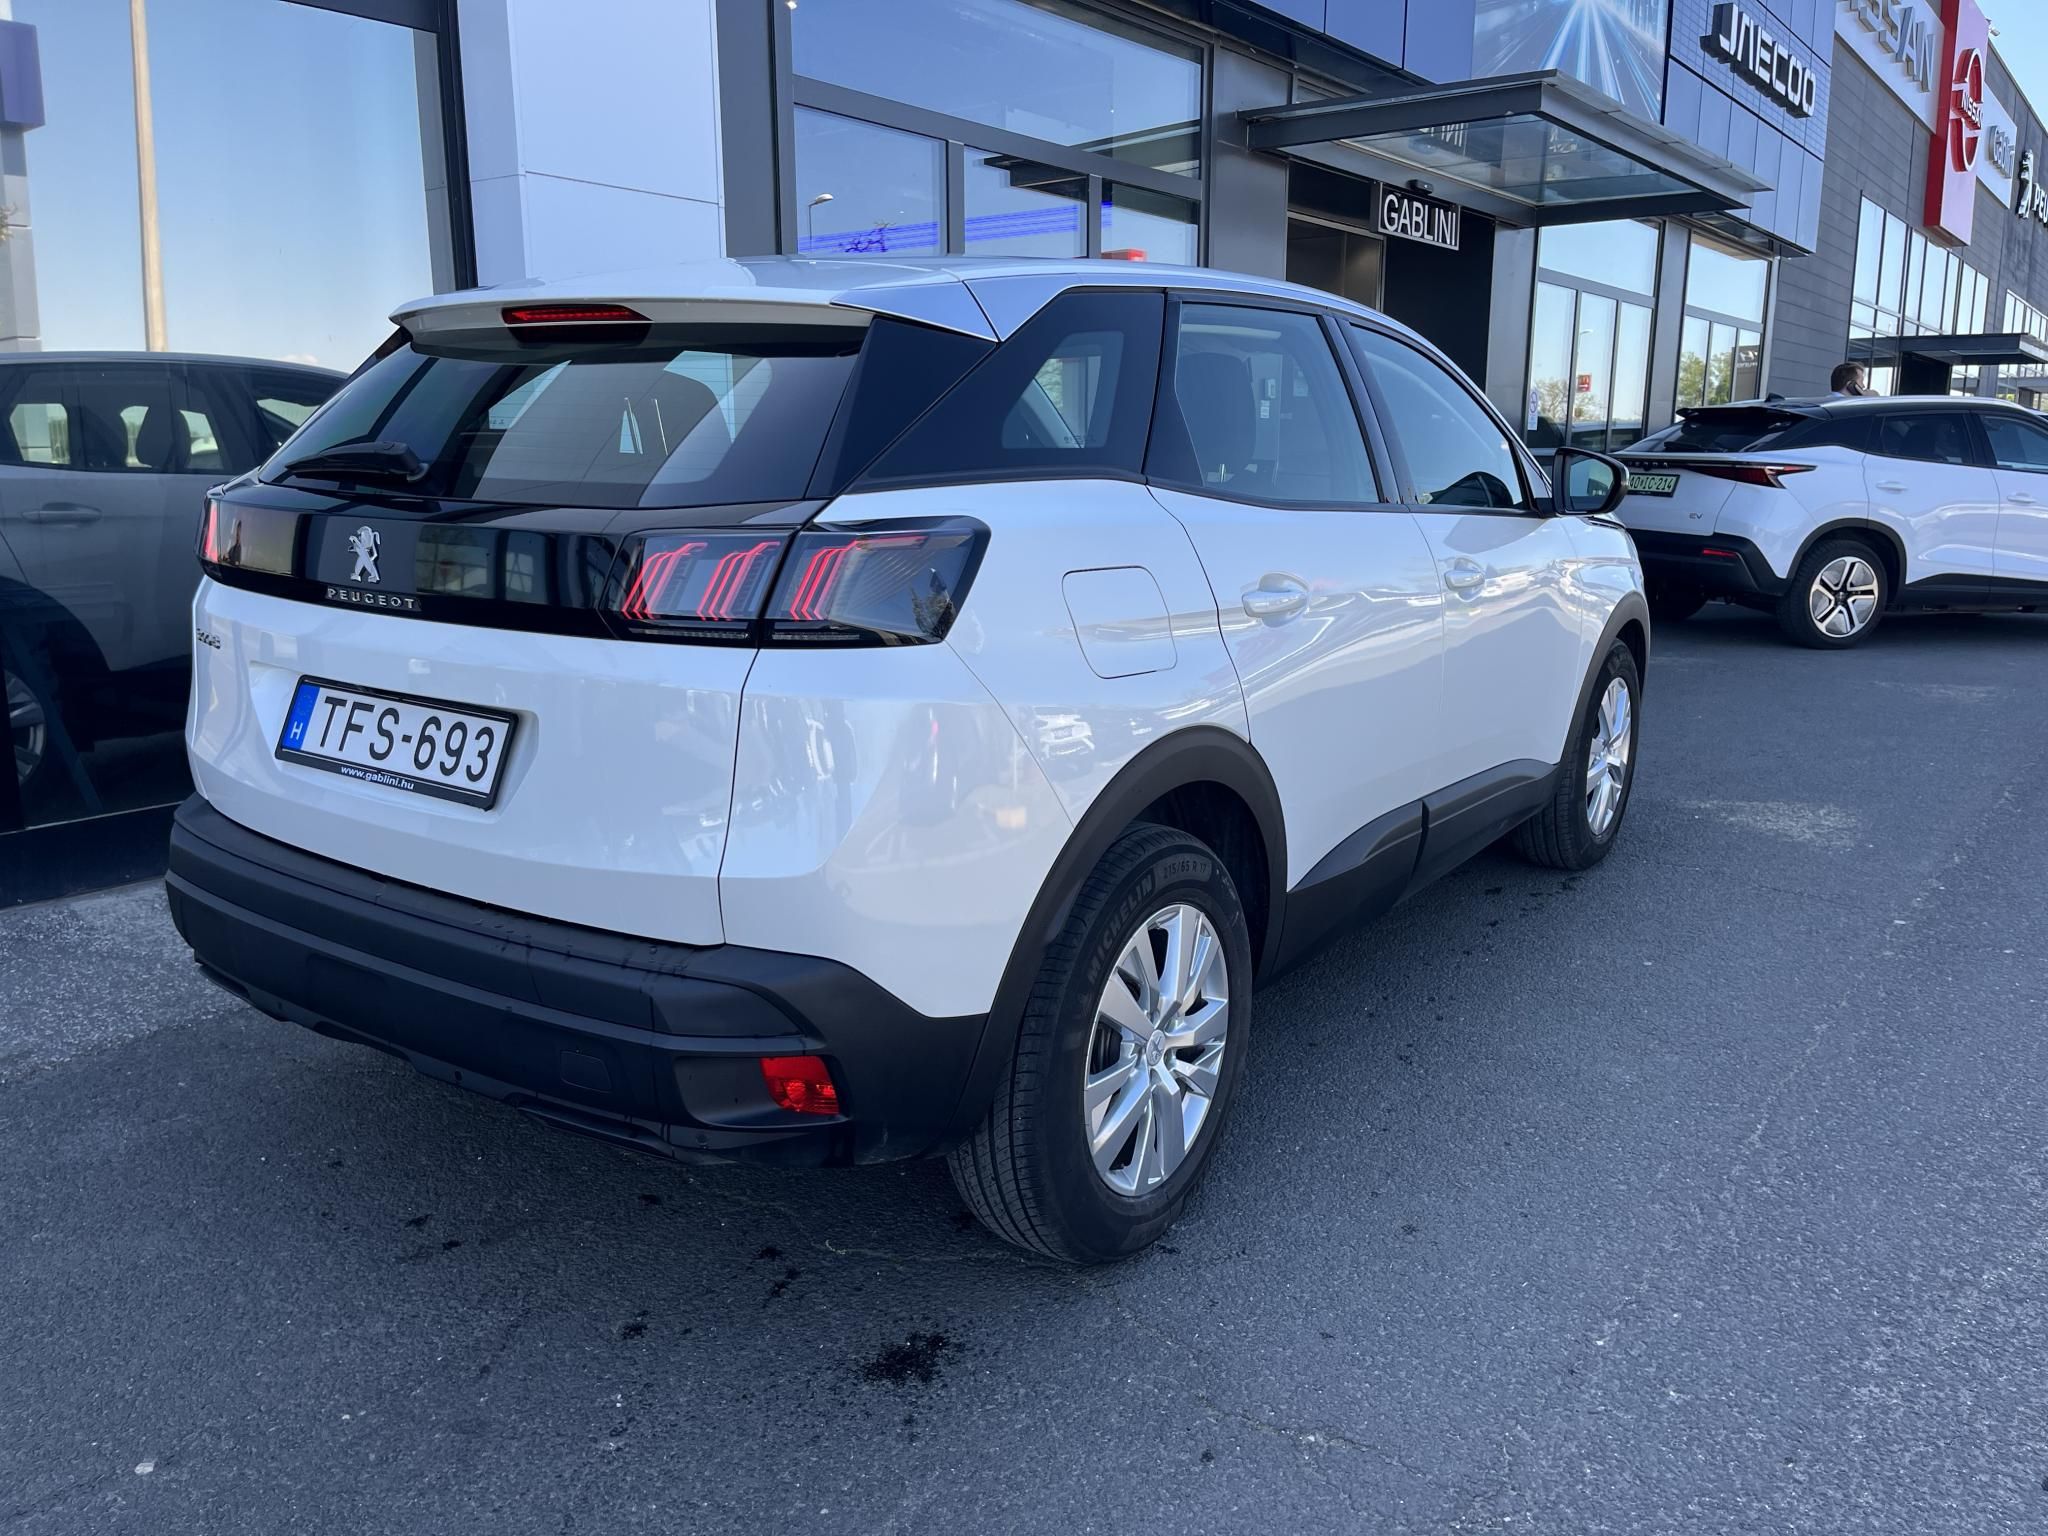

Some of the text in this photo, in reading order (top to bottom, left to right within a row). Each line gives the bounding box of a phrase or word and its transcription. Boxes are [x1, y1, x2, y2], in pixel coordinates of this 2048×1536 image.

[1383, 193, 1456, 246] GABLINI
[327, 586, 415, 609] PEUGEOT
[290, 721, 304, 741] H
[320, 696, 495, 783] TFS-693
[340, 766, 415, 790] www.gablini.hu
[1087, 873, 1152, 983] MICHELIN
